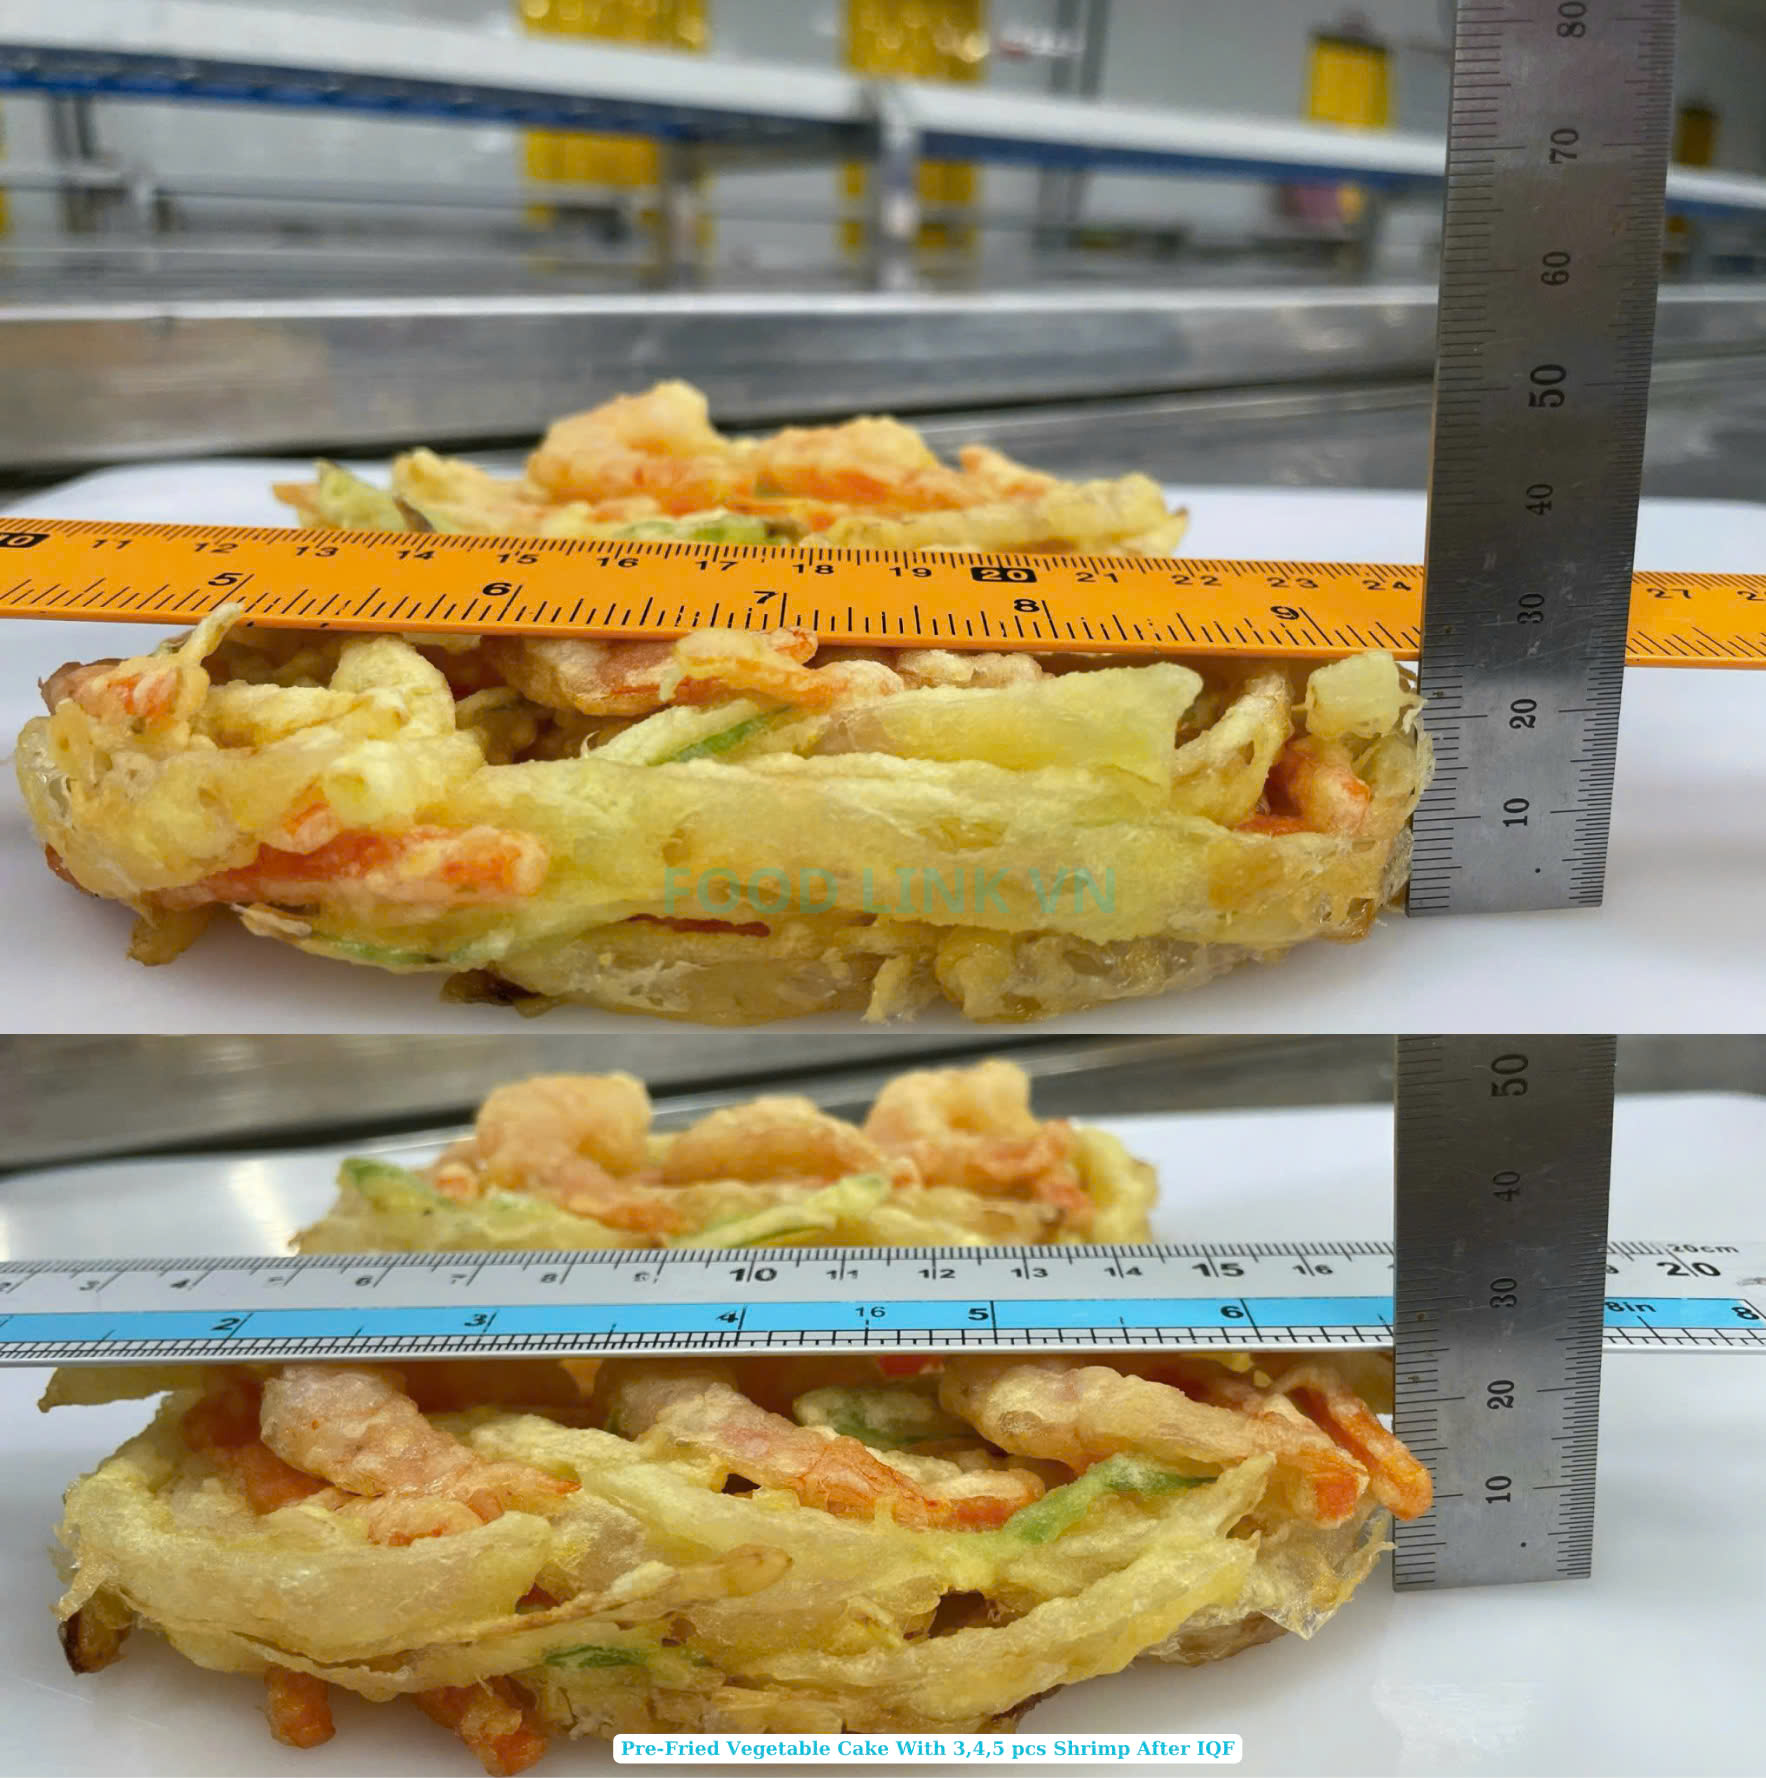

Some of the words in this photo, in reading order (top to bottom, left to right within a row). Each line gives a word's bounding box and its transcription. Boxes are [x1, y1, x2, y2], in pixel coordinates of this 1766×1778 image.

[1556, 1, 1587, 39] 80
[1549, 128, 1580, 165] 70
[1540, 251, 1571, 287] 60
[1528, 363, 1567, 408] 50
[1525, 483, 1553, 516] 40
[91, 538, 132, 551] 11
[193, 541, 239, 555] 12
[295, 545, 339, 559] 13
[395, 549, 435, 561] 14
[496, 552, 539, 565] 15
[596, 556, 640, 569] 16
[695, 560, 738, 572] 17
[792, 563, 835, 576] 18
[888, 566, 933, 579] 19
[979, 569, 1029, 582] 20
[1077, 571, 1120, 584] 21
[1172, 574, 1222, 587] 22
[1267, 576, 1319, 590] 23
[1361, 579, 1411, 591] 24
[1646, 587, 1692, 600] 27
[208, 572, 243, 587] 5
[482, 581, 512, 597] 6
[753, 590, 777, 605] 7
[1013, 598, 1041, 613] 8
[1269, 605, 1300, 621] 9
[1516, 592, 1545, 625] 30
[1509, 698, 1538, 730] 20
[1502, 797, 1530, 828] 10
[1491, 1052, 1529, 1097] 50
[1492, 1170, 1521, 1202] 40
[1667, 1243, 1740, 1254] 20cm
[540, 1272, 558, 1284] 8
[729, 1267, 778, 1283] 10
[826, 1269, 859, 1281] 11
[918, 1268, 956, 1280] 12
[1010, 1267, 1049, 1279] 13
[1104, 1266, 1143, 1278] 14
[1191, 1262, 1245, 1278] 15
[1292, 1263, 1334, 1276] 16
[1656, 1261, 1721, 1277] 20
[1490, 1277, 1518, 1309] 30
[210, 1317, 240, 1331] 2
[464, 1312, 488, 1327] 3
[715, 1310, 738, 1324] 4
[855, 1305, 886, 1318] 16
[967, 1307, 990, 1321] 5
[1220, 1304, 1244, 1319] 6
[1731, 1306, 1759, 1320] 8
[1487, 1379, 1515, 1410] 20
[1485, 1475, 1512, 1504] 10
